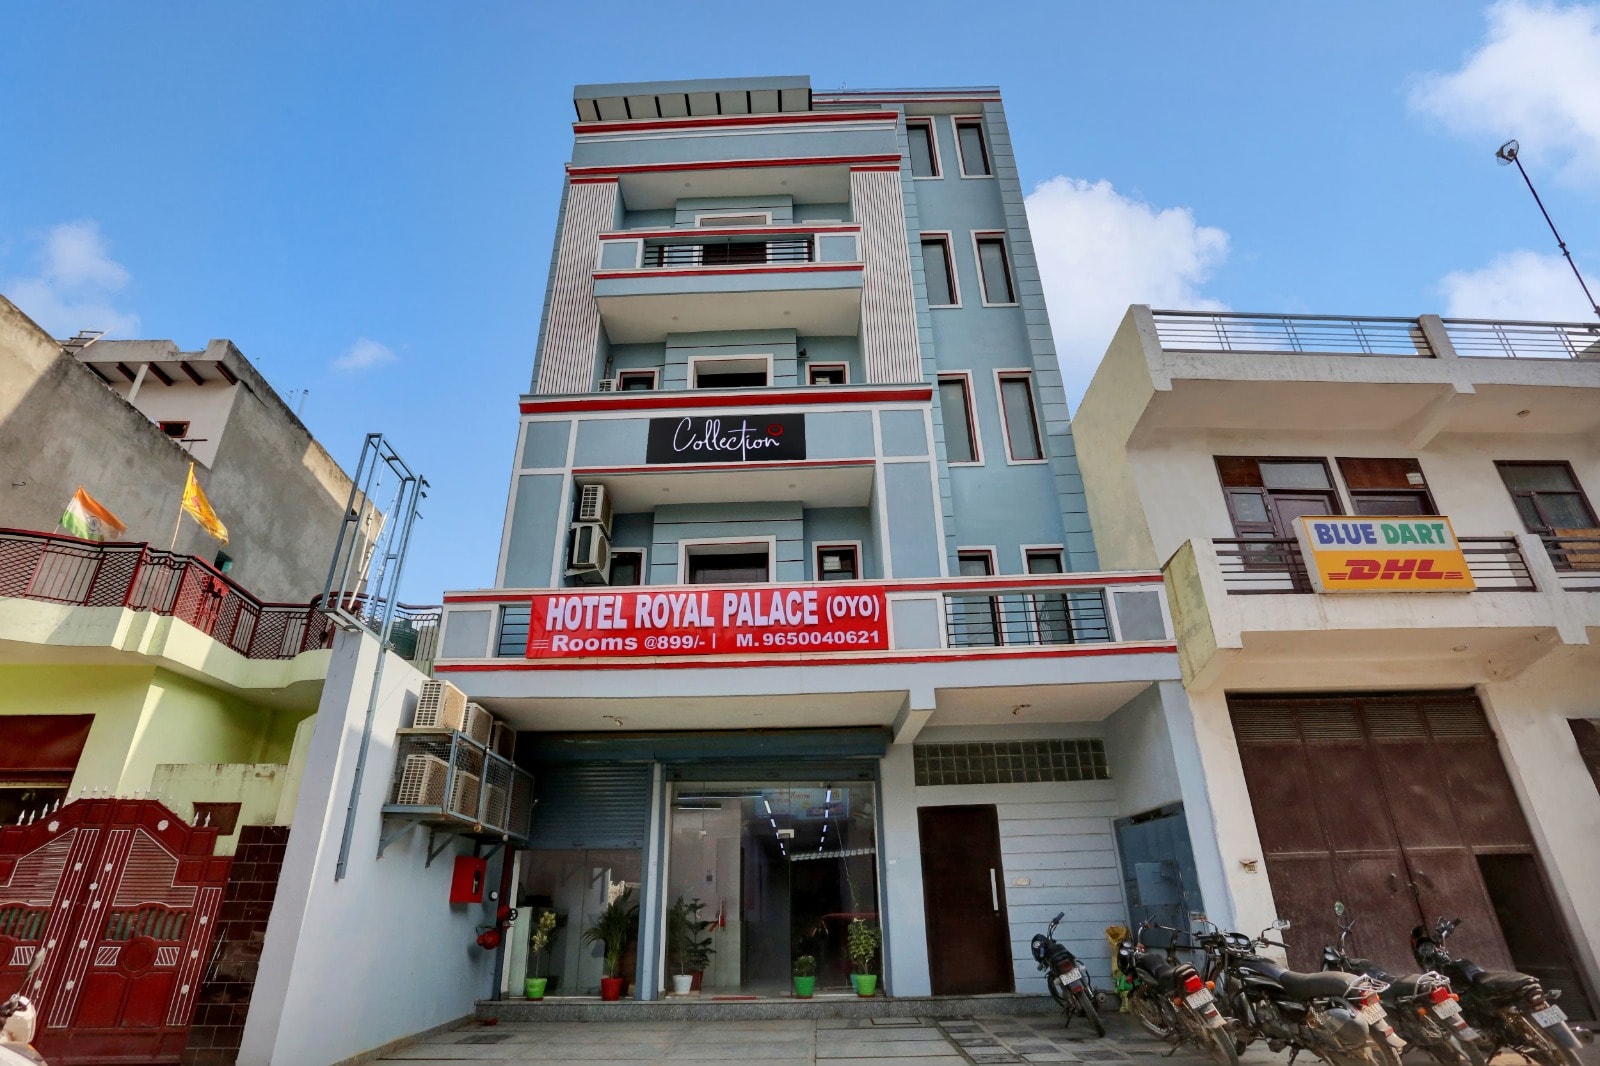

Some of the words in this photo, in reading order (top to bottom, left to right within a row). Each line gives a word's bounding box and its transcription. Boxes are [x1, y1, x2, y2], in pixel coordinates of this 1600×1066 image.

[673, 416, 780, 463] Collection
[1314, 523, 1377, 545] BLUE
[1380, 523, 1446, 545] DART
[1345, 559, 1445, 580] DHL
[545, 595, 628, 632] HOTEL
[635, 592, 715, 629] ROYAL
[722, 590, 819, 628] PALACE
[826, 594, 880, 624] (OYO)
[551, 634, 638, 652] Rooms
[762, 630, 879, 646] 9650040621
